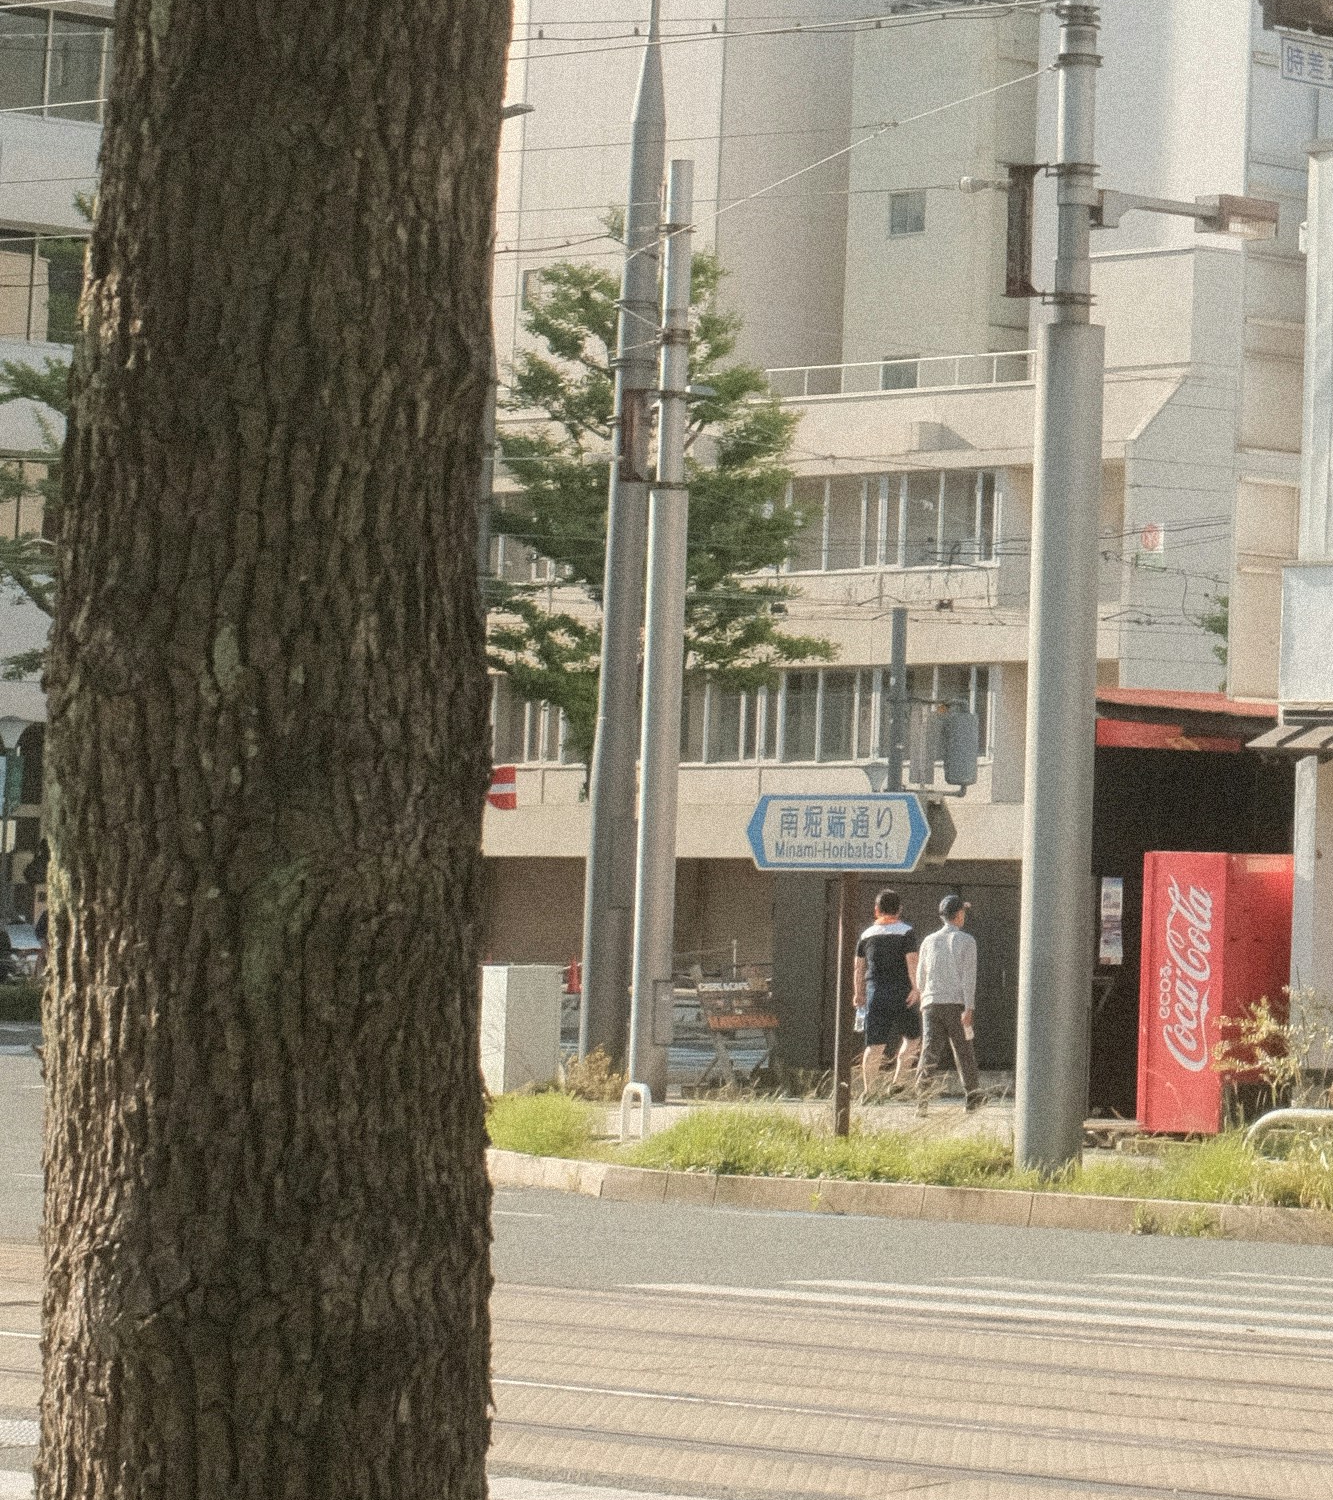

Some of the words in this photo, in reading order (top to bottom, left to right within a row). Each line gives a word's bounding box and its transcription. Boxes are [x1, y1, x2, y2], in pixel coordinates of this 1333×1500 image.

[779, 804, 894, 839] 南堀端通り
[1163, 873, 1214, 1072] Coca-Cola
